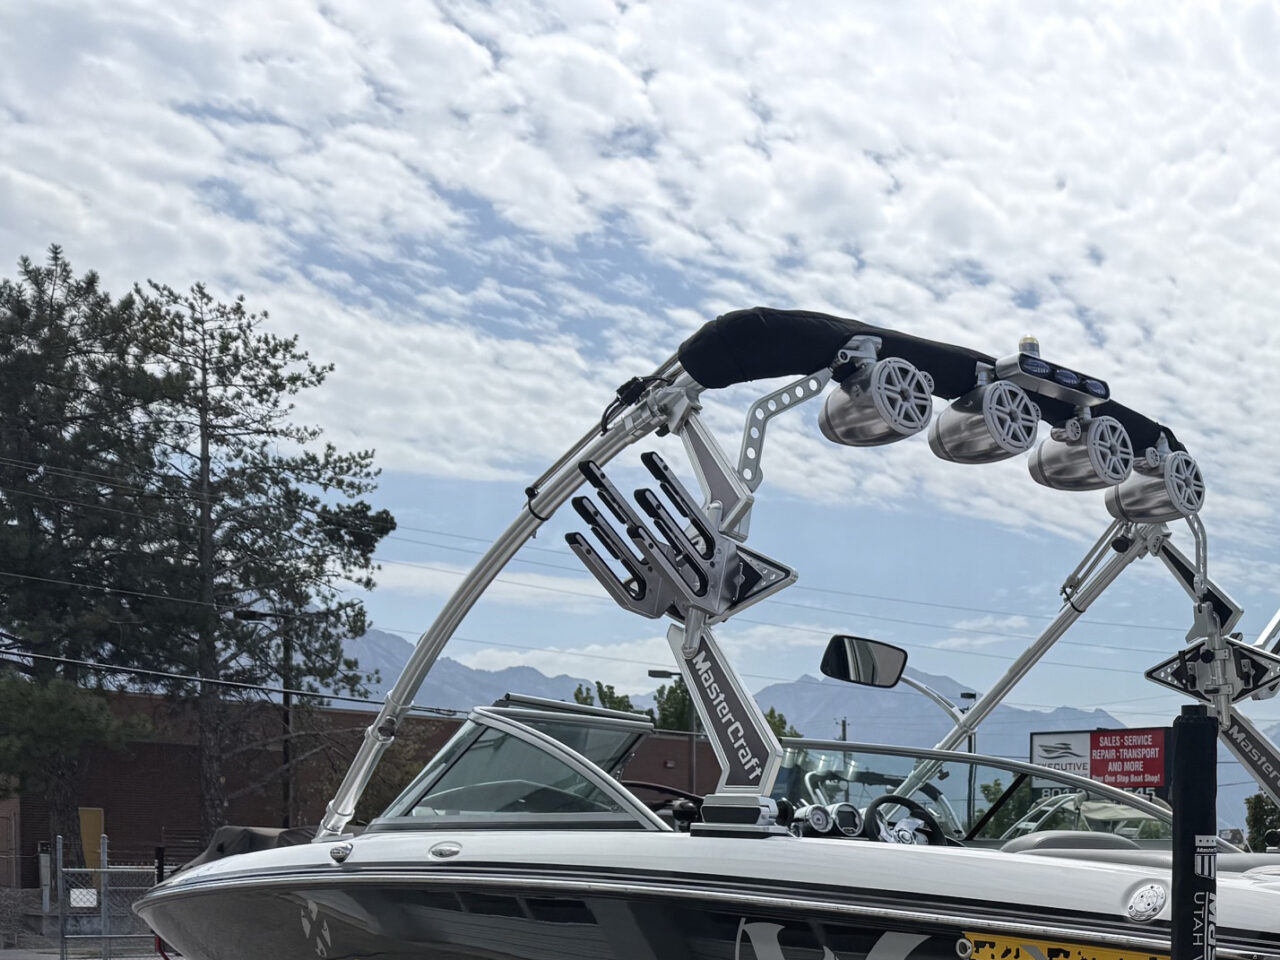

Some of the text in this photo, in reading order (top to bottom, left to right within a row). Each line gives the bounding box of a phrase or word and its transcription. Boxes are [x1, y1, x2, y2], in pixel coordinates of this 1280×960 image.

[692, 650, 762, 780] MasterCraft
[1038, 761, 1088, 771] ECUTIVE
[1108, 761, 1144, 772] AND MORE
[1117, 774, 1129, 784] Stop
[1130, 774, 1144, 782] Boat
[1192, 892, 1205, 946] UTAH
